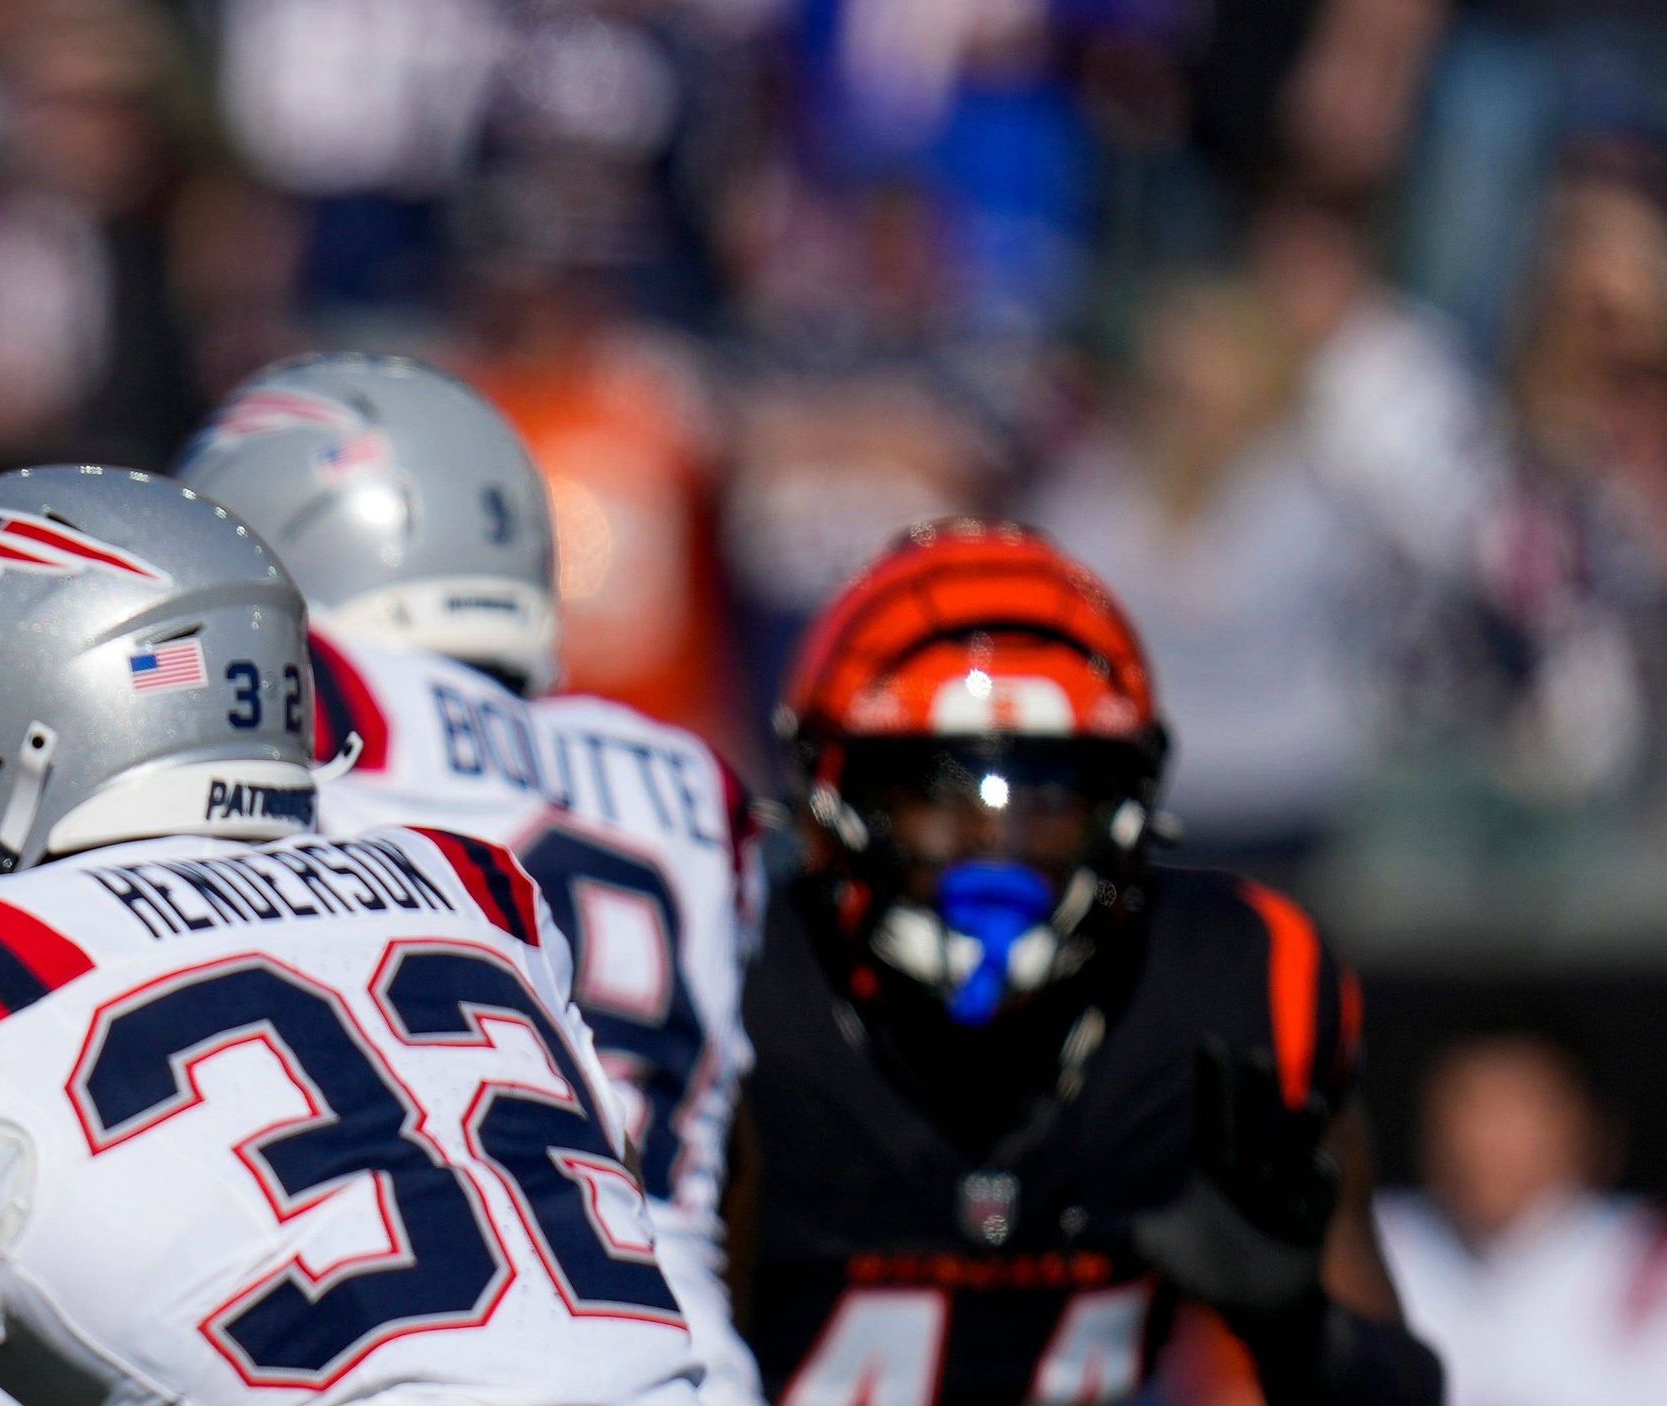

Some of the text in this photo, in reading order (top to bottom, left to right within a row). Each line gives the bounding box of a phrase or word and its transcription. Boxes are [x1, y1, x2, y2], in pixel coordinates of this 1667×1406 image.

[224, 658, 304, 735] 32
[82, 838, 457, 940] HENDERSON
[64, 937, 691, 1394] 32
